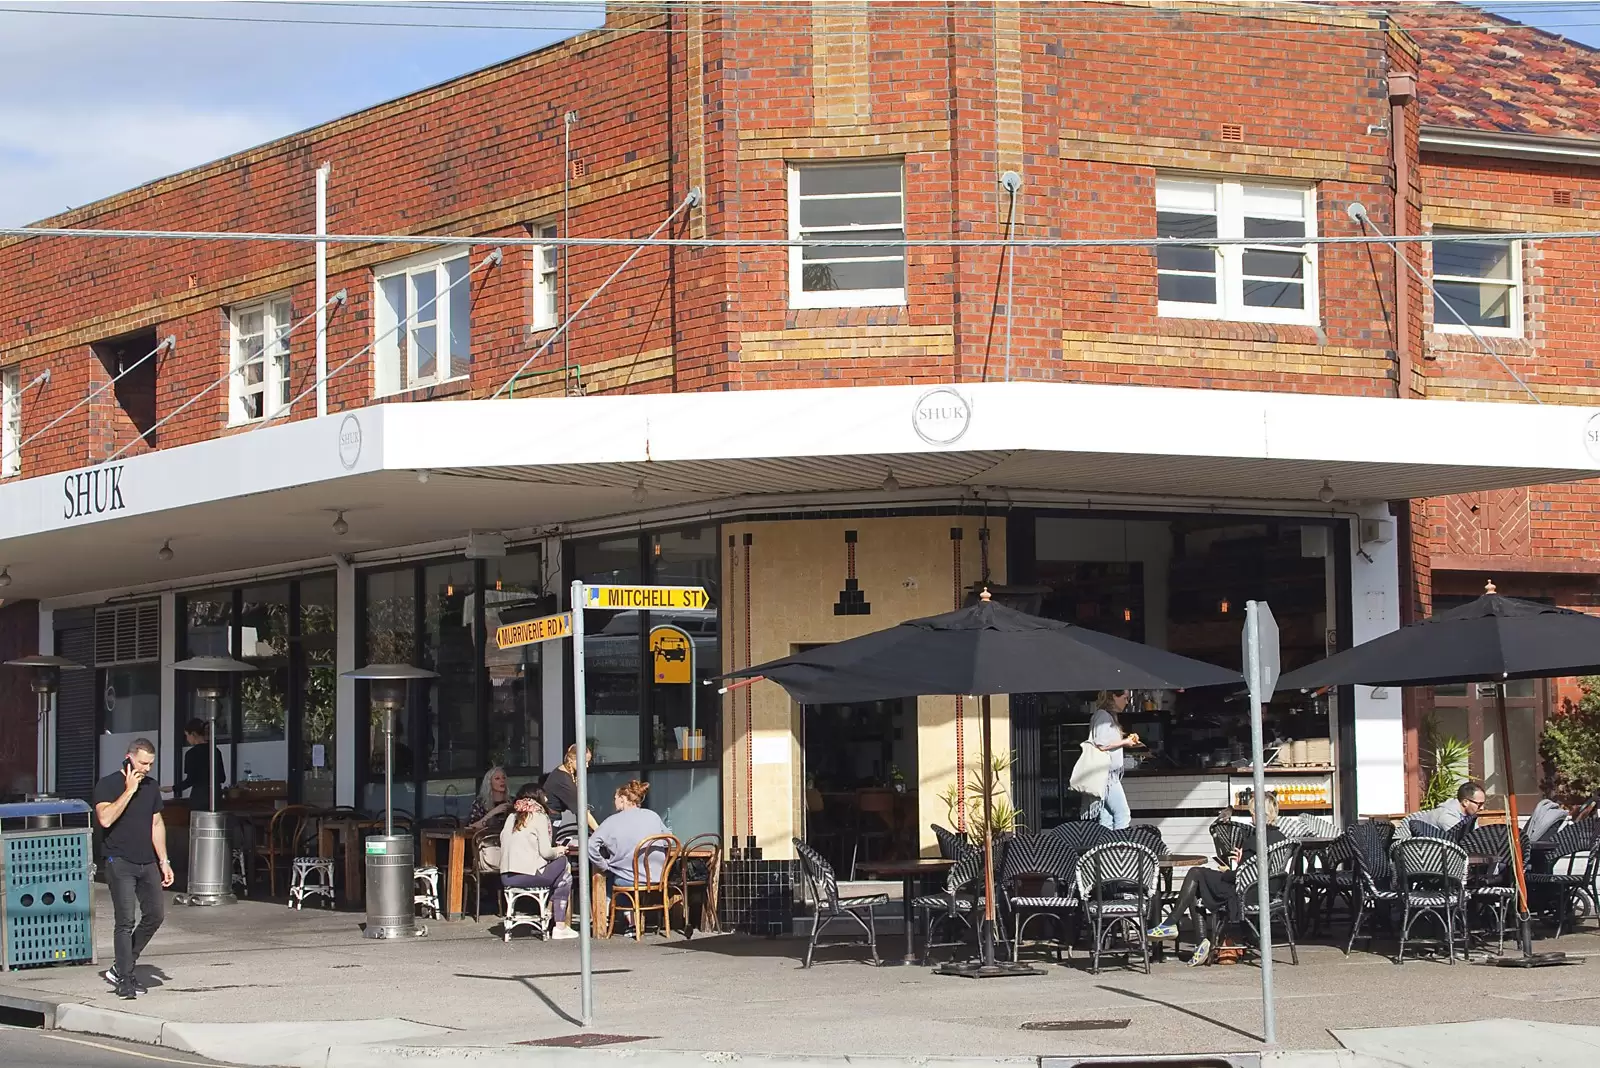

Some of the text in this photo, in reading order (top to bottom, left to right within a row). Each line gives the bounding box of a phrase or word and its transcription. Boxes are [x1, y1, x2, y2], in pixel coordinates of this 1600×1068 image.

[919, 406, 964, 420] SHUK
[340, 431, 360, 446] SHUK
[64, 465, 125, 520] SHUK
[608, 589, 700, 607] MITCHELL ST
[501, 619, 558, 645] MURRIVERIE RD
